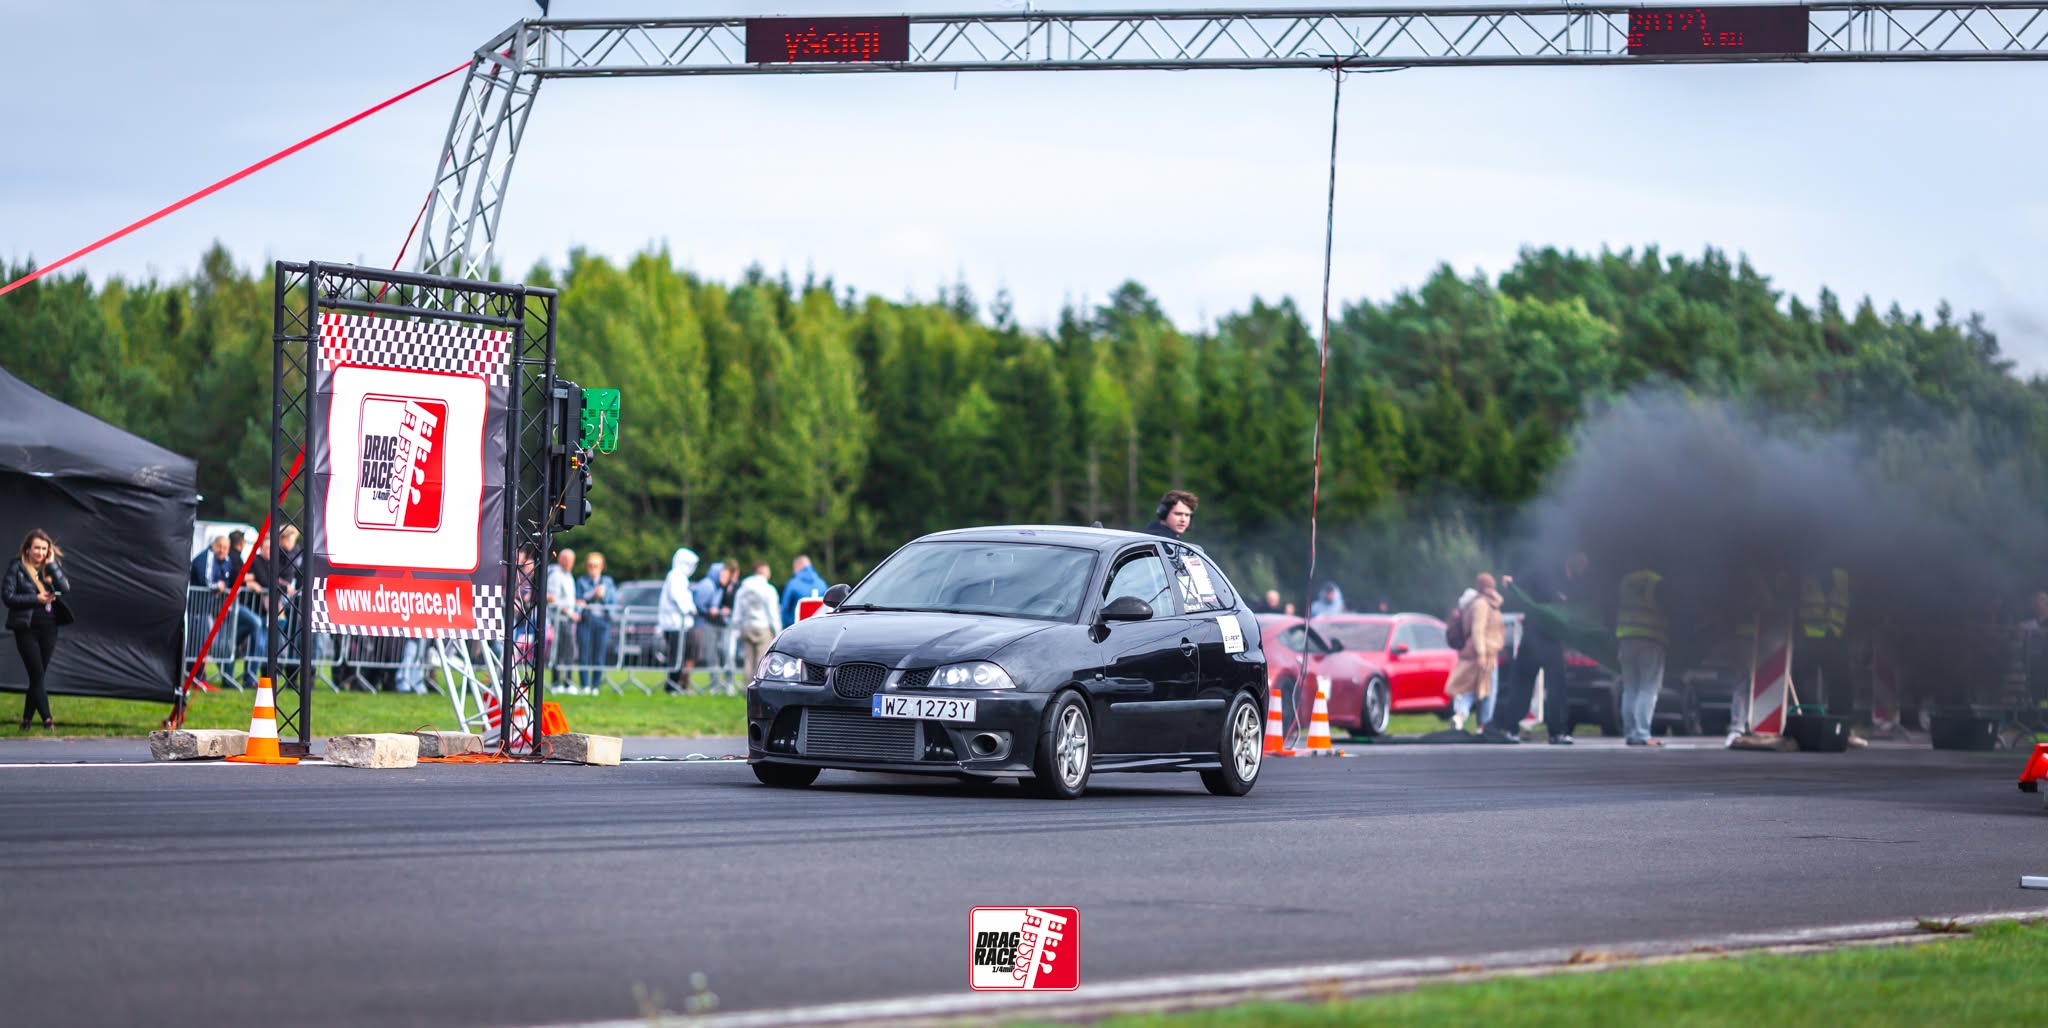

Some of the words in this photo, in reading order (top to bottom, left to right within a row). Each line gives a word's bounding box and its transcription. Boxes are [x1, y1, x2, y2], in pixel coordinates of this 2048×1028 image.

[363, 434, 398, 462] DRAG
[361, 460, 394, 489] RACE
[335, 584, 462, 623] www.dragrace.pl
[885, 698, 907, 716] WZ
[916, 699, 970, 719] 1273Y
